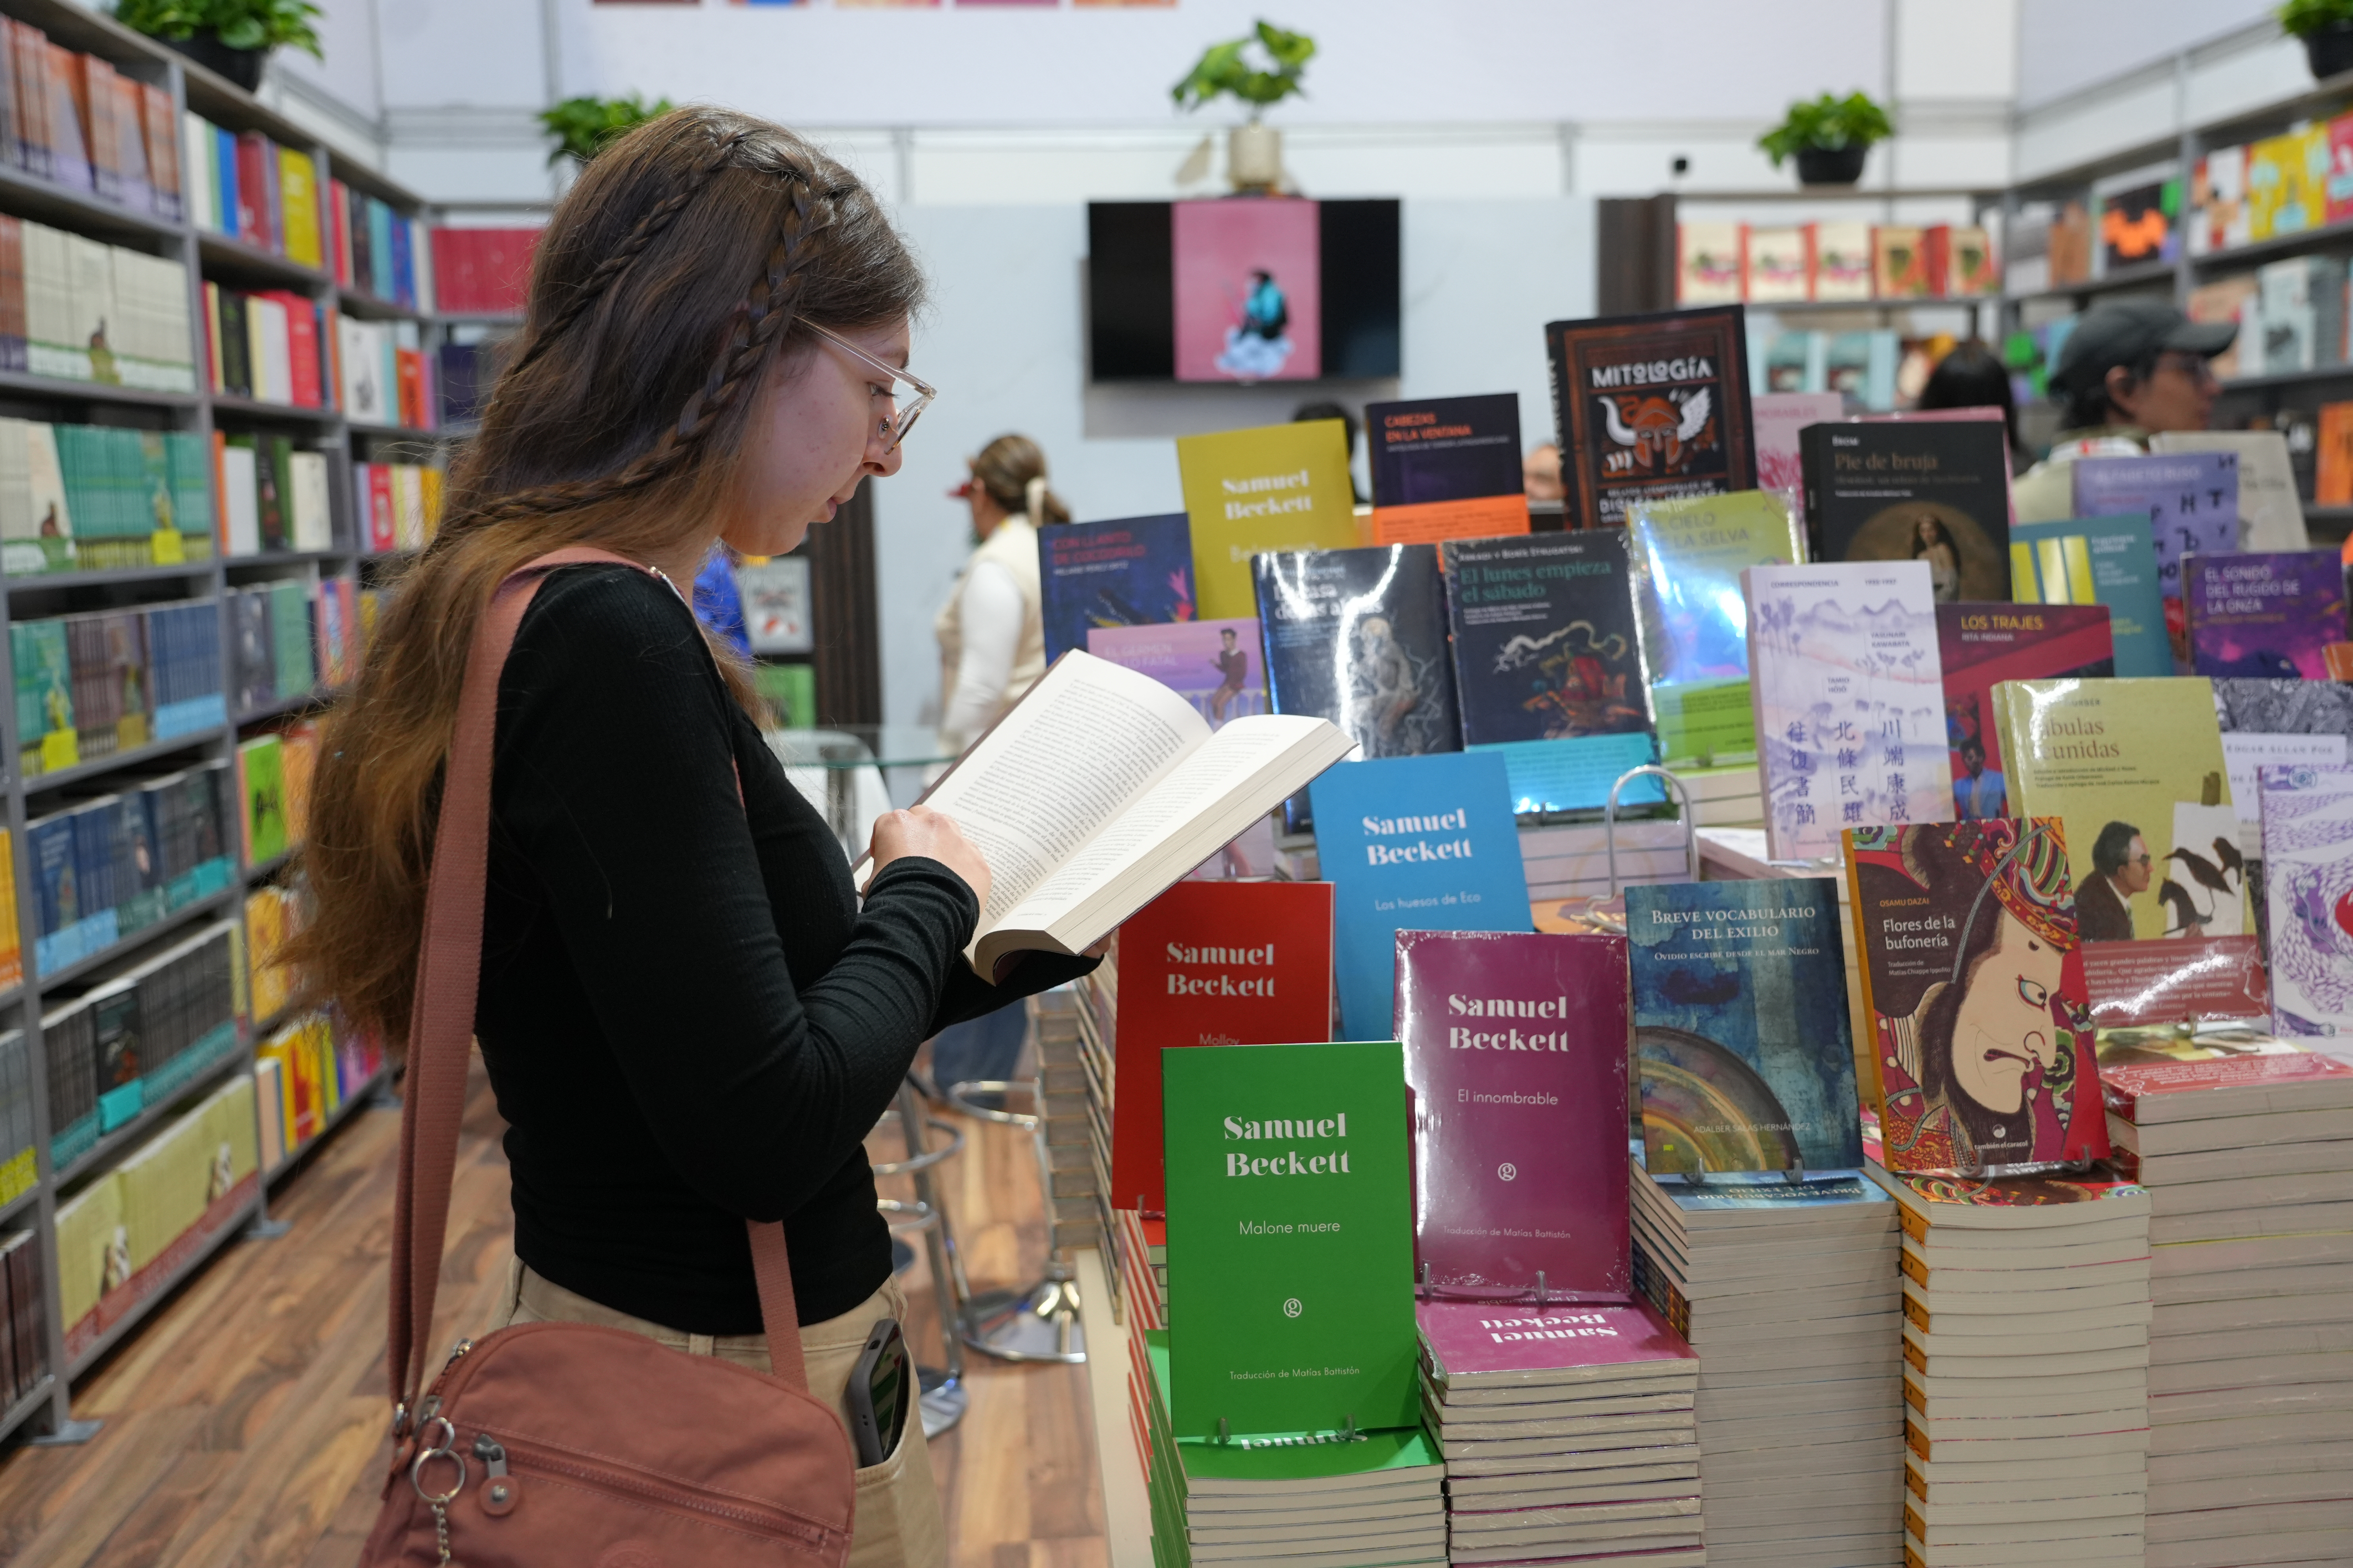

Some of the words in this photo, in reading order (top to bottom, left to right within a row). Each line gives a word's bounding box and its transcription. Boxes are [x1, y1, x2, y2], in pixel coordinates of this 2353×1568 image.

[1592, 356, 1714, 388] MITOLOGÍA
[1865, 452, 1887, 470] de
[1222, 469, 1309, 495] Samuel
[1225, 496, 1313, 520] Beckett
[1482, 566, 1532, 583] lunes
[1536, 561, 1612, 580] empieza
[1771, 579, 1839, 589] CORRESPONDENCIA
[1961, 615, 1989, 630] LOS
[1991, 615, 2044, 630] TRAJES
[1961, 632, 1979, 642] RITA
[1981, 632, 2014, 642] INDIANA
[2041, 739, 2120, 760] eunidas
[1882, 719, 1910, 821] 川端康成
[1362, 808, 1467, 836] Samuel
[1032, 837, 1051, 854] contraste
[1050, 854, 1059, 862] más
[1367, 838, 1472, 866] Beckett
[1026, 860, 1043, 877] dirección:
[1032, 857, 1047, 873] relaciona
[997, 880, 1010, 892] tomada
[1005, 880, 1017, 891] puede
[1008, 875, 1018, 884] tanto
[1010, 869, 1022, 880] campo
[1022, 880, 1031, 888] tiene
[988, 895, 1000, 908] mismo,
[997, 895, 1009, 908] agujero
[1001, 891, 1013, 904] después
[1375, 899, 1395, 911] Los
[1397, 897, 1439, 908] huesos
[1442, 893, 1457, 905] de
[1460, 891, 1481, 904] Eco
[1908, 897, 1930, 906] DAZAI
[985, 908, 996, 920] objeto.
[1652, 909, 1701, 924] BREVE
[1705, 907, 1816, 922] VOCABULARIO
[1883, 918, 1922, 932] Flores
[1925, 916, 1940, 929] de
[1944, 915, 1955, 929] la
[1693, 928, 1721, 940] DEL
[1727, 926, 1779, 938] EXILIO
[1885, 933, 1949, 950] bufonería
[1167, 942, 1274, 965] Samuel
[1654, 952, 1688, 961] OVIDIO
[1690, 951, 1722, 959] ESCRIBE
[1788, 946, 1820, 955] NEGRO
[1167, 974, 1275, 996] Beckett
[1448, 994, 1567, 1019] Samuel
[1450, 1027, 1569, 1052] Beckett
[1458, 1089, 1468, 1102] El
[1473, 1091, 1558, 1105] innombrable
[1224, 1113, 1347, 1140] Samuel
[1694, 1124, 1730, 1133] ADALBER
[1732, 1123, 1757, 1132] SALAS
[1760, 1122, 1811, 1132] HERNÁNDEZ
[1224, 1150, 1351, 1176] Beckett
[1240, 1221, 1293, 1235] Malone
[1298, 1222, 1340, 1232] muere
[1443, 1226, 1487, 1235] Traducción
[1490, 1227, 1501, 1236] de
[1504, 1228, 1532, 1237] Matías
[1535, 1229, 1570, 1238] Battistón
[1480, 1314, 1606, 1329] Beckett
[1490, 1327, 1618, 1343] Samuel
[1230, 1370, 1275, 1380] Traducción
[1293, 1368, 1321, 1377] Matías
[1324, 1366, 1360, 1375] Battistón
